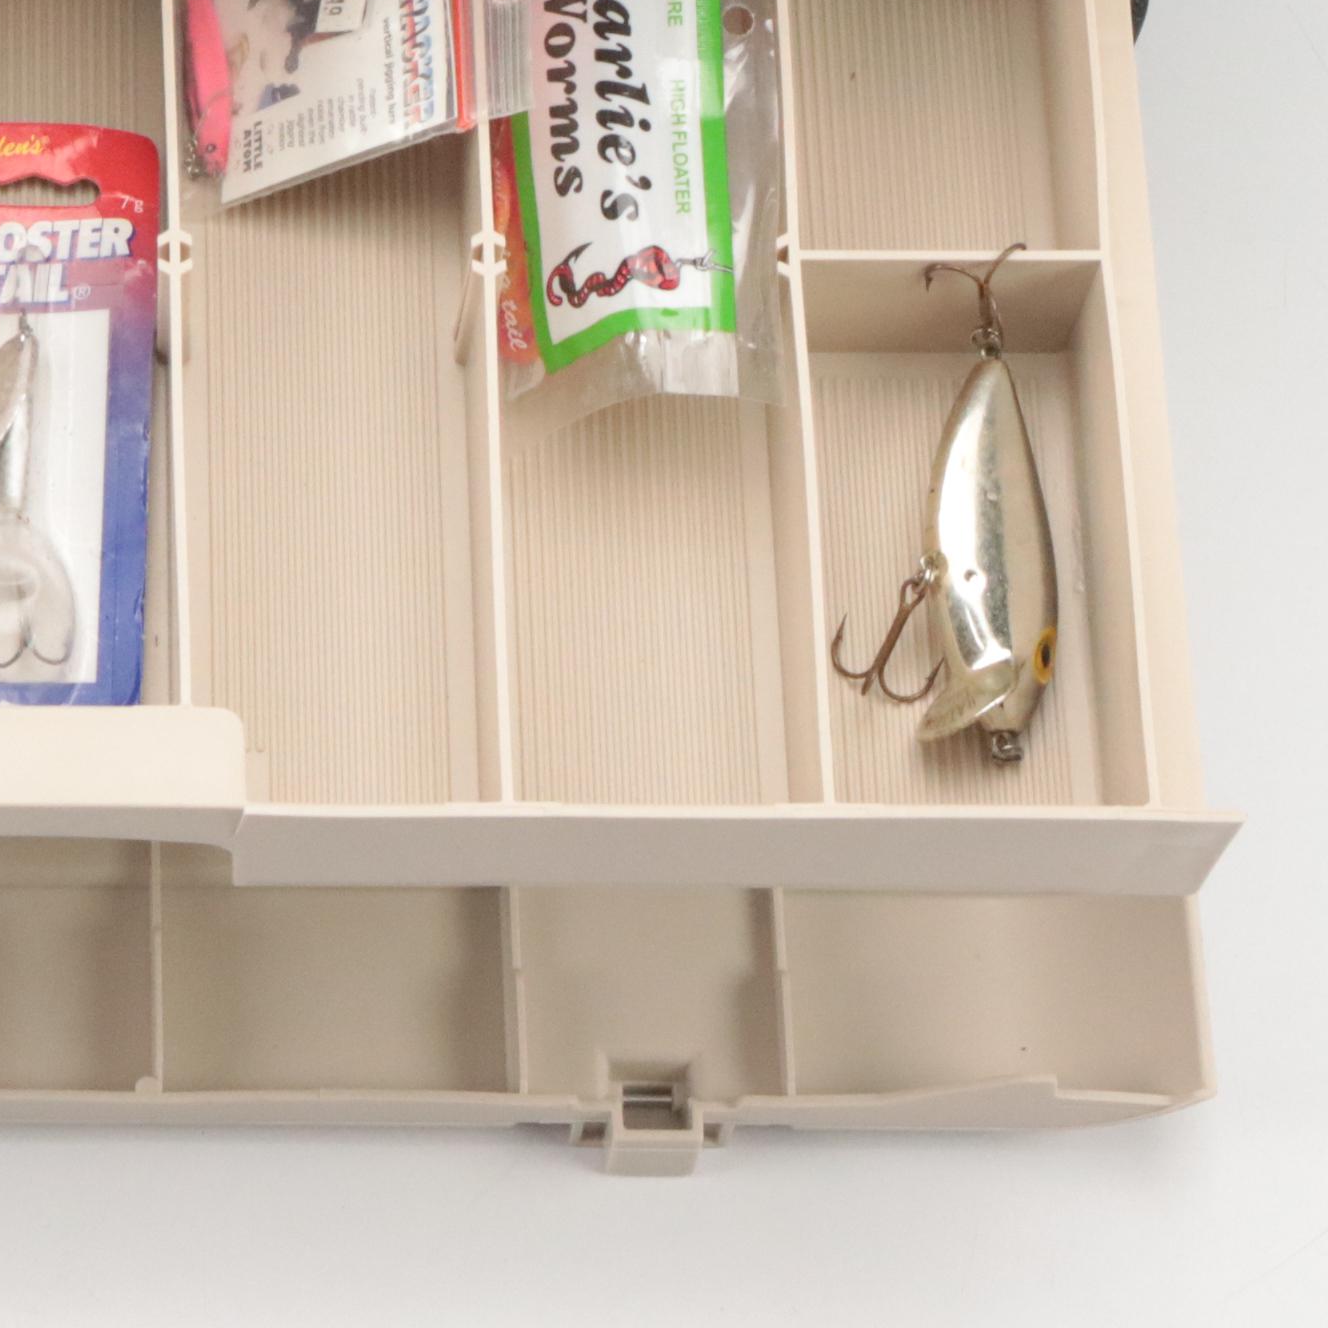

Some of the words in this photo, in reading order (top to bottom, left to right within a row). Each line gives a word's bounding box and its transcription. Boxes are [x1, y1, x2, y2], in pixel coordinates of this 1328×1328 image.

[381, 17, 394, 59] vertical
[672, 79, 684, 127] HIGH
[242, 129, 253, 172] ATOM
[253, 120, 264, 170] LITTLE
[672, 130, 692, 214] FLOATER
[501, 298, 528, 353] tail
